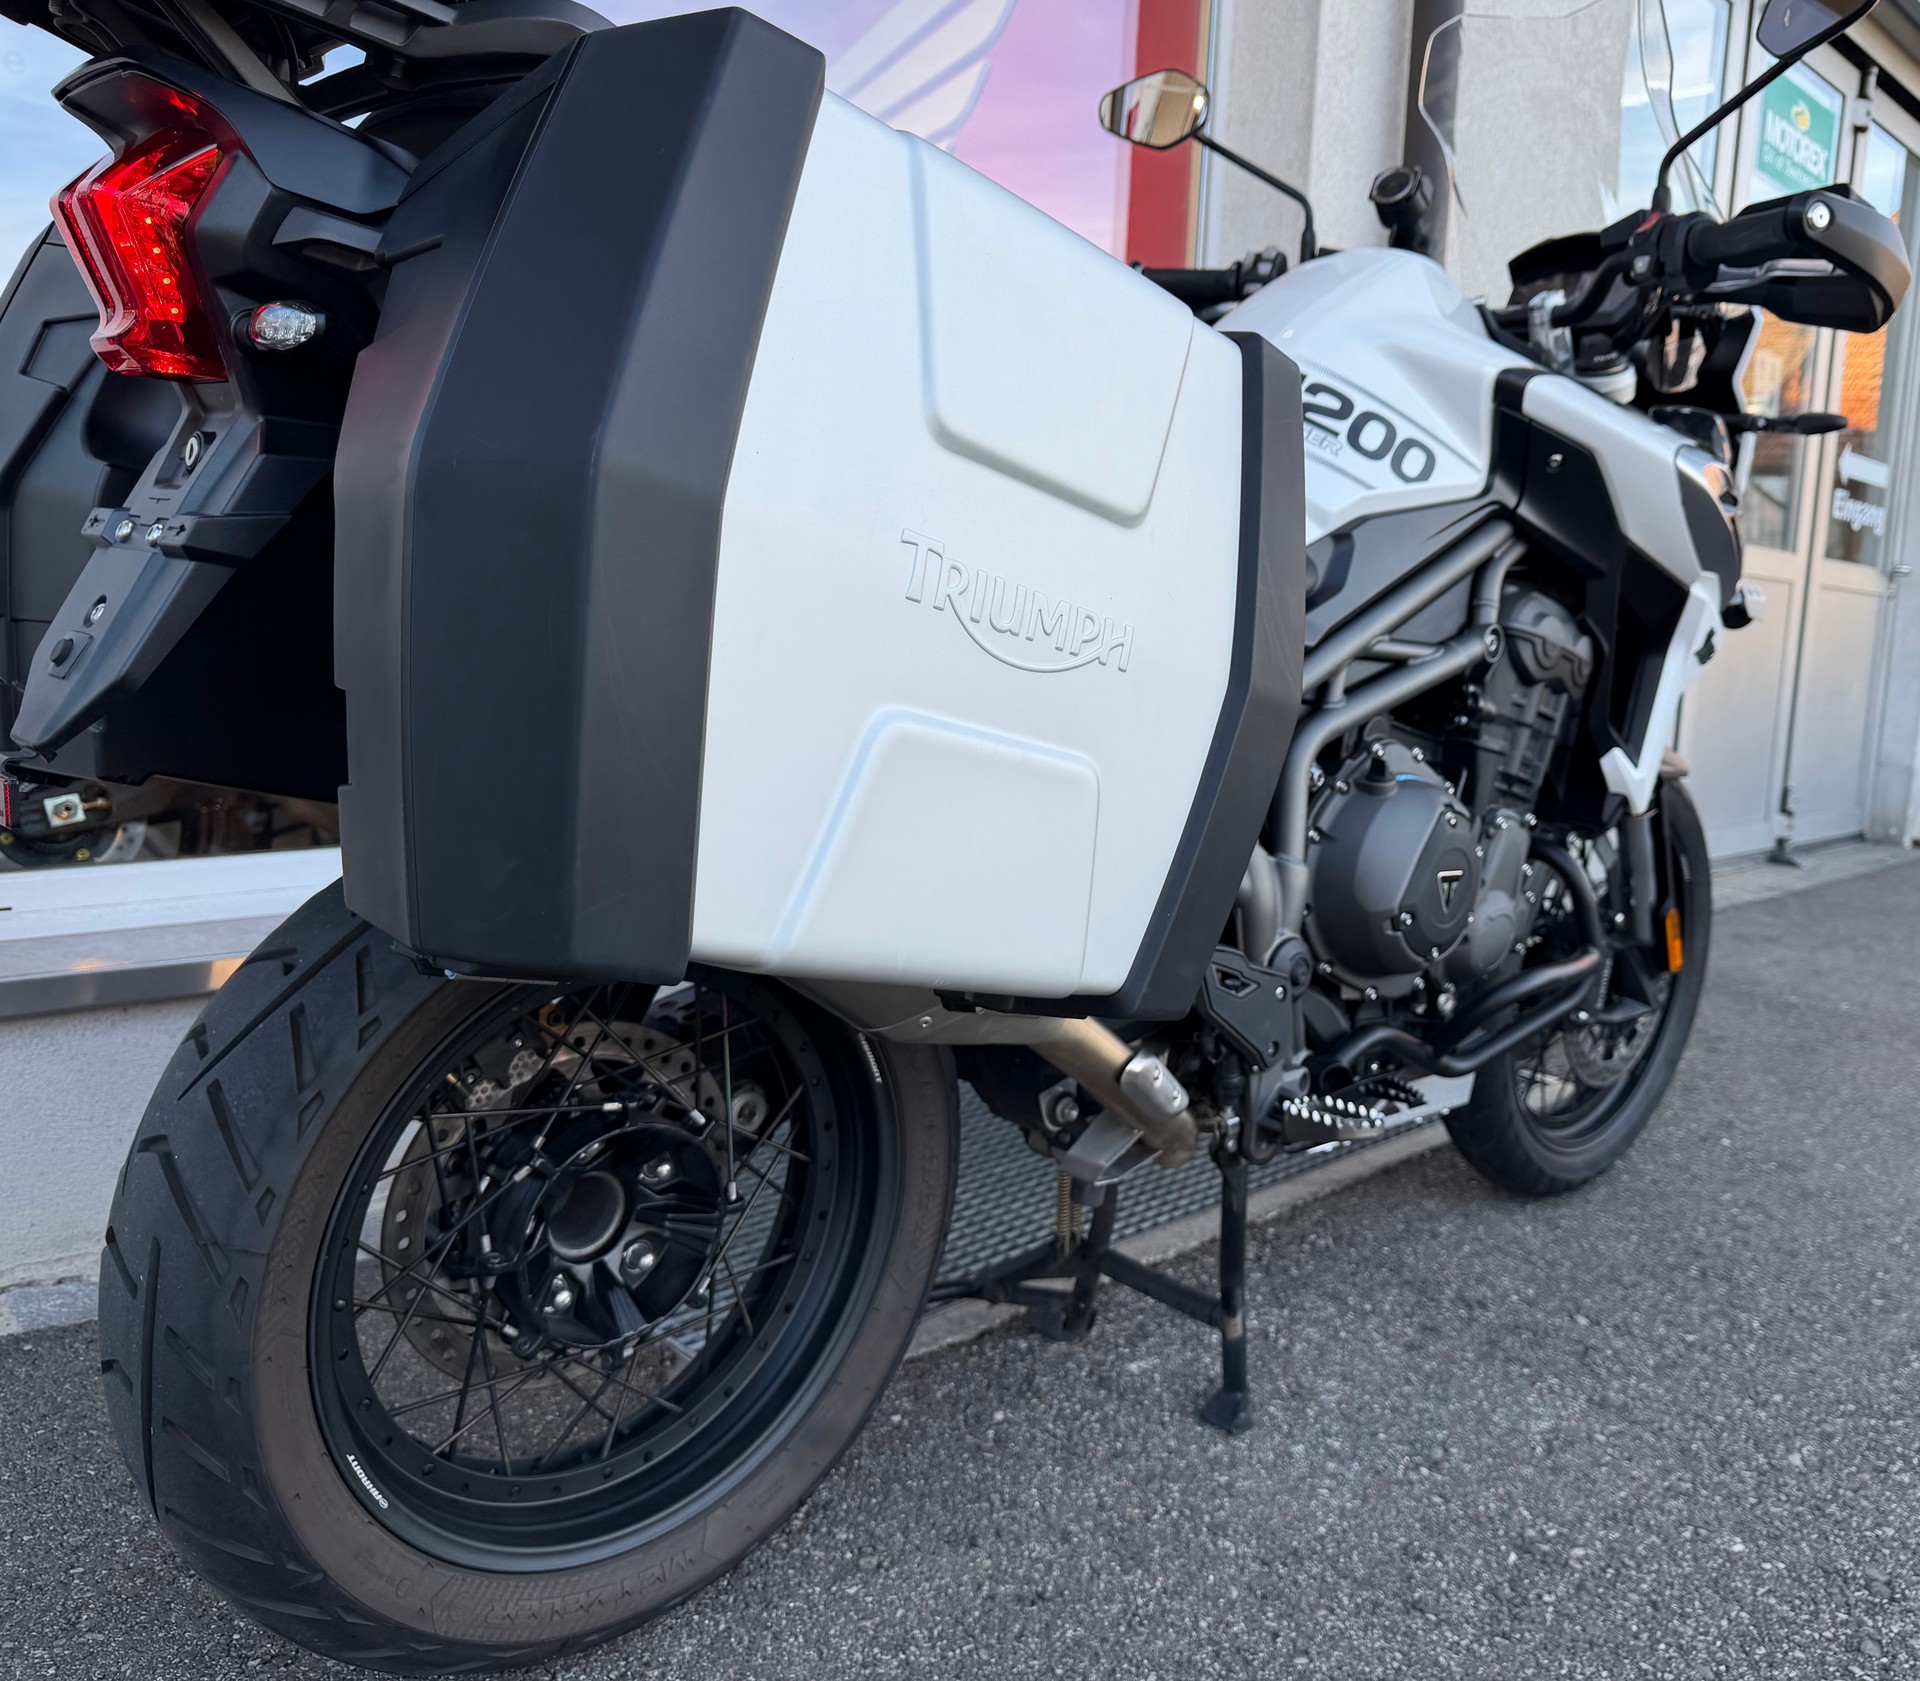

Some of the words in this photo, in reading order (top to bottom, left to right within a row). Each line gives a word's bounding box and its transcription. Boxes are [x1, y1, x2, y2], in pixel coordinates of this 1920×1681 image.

[1763, 108, 1828, 181] MOTOREX
[1301, 373, 1436, 484] 200
[1832, 487, 1885, 537] Eingang
[901, 527, 1135, 674] TRIUMPH
